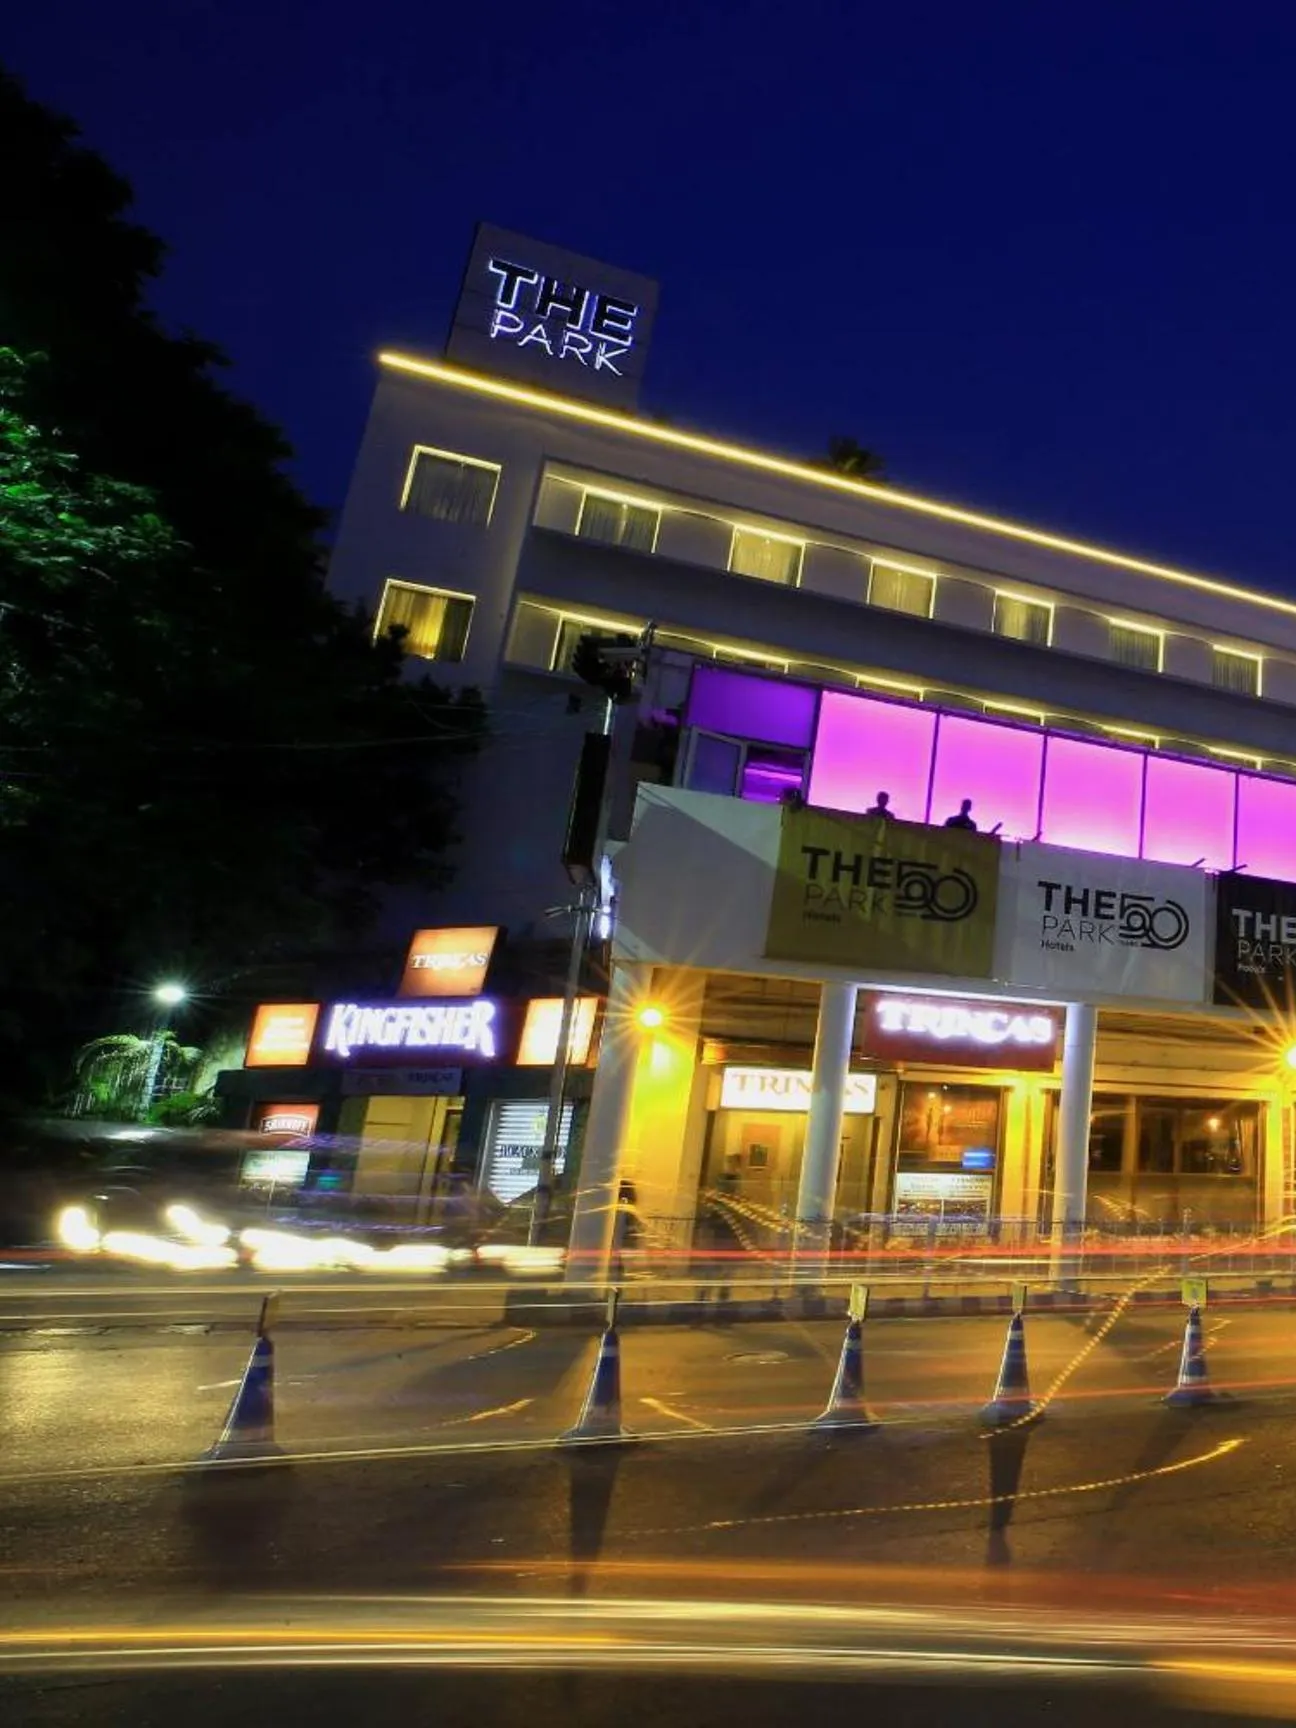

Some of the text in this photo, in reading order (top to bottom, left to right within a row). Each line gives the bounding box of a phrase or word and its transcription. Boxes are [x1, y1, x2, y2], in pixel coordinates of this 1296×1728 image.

[488, 257, 639, 346] THE
[490, 308, 628, 376] PARK
[801, 846, 893, 889] THE
[803, 883, 888, 916] PARK
[1037, 880, 1117, 920] THE
[1042, 914, 1116, 945] PARK
[325, 1001, 496, 1057] KINGFISHER
[876, 1000, 1053, 1043] TRINCAS
[732, 1073, 869, 1096] TRINS
